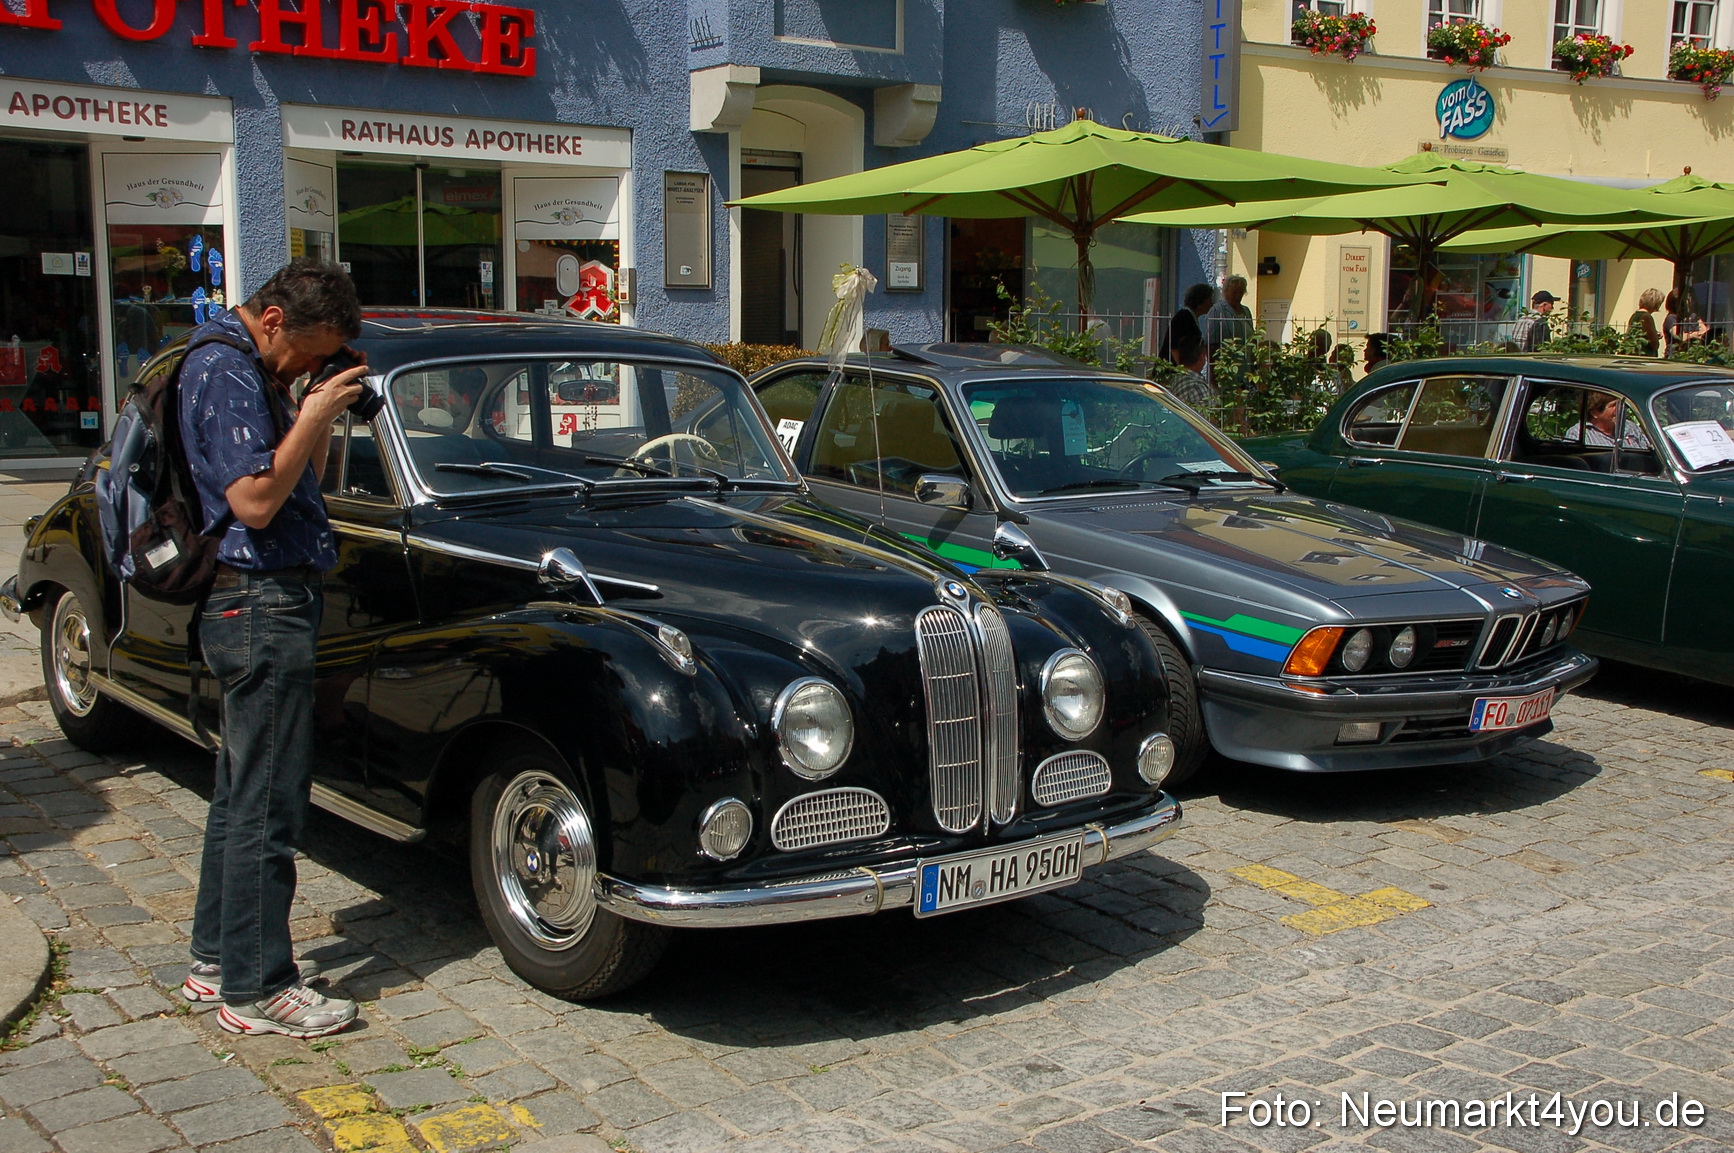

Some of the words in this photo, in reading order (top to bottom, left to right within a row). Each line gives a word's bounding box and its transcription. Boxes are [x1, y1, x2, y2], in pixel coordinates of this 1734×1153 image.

[8, 90, 169, 128] APOTHEKE
[1442, 86, 1466, 110] vom
[1026, 97, 1056, 130] CAFÉ
[1440, 90, 1487, 138] FASS
[341, 119, 455, 148] RATHAUS
[465, 128, 583, 156] APOTHEKE
[1443, 144, 1474, 156] Probieren
[126, 179, 147, 192] Haus
[147, 177, 160, 187] der
[161, 177, 205, 192] Gesundheit
[446, 189, 489, 202] elmex
[533, 201, 551, 211] Haus
[552, 199, 564, 207] der
[564, 198, 604, 211] Gesundheit
[783, 421, 799, 431] ADAC
[1706, 429, 1724, 442] 23
[1482, 702, 1508, 727] FO
[1516, 692, 1552, 724] 07111
[925, 892, 932, 903] D
[938, 863, 972, 903] NM
[989, 855, 1019, 893] HA
[1025, 841, 1081, 886] 950H
